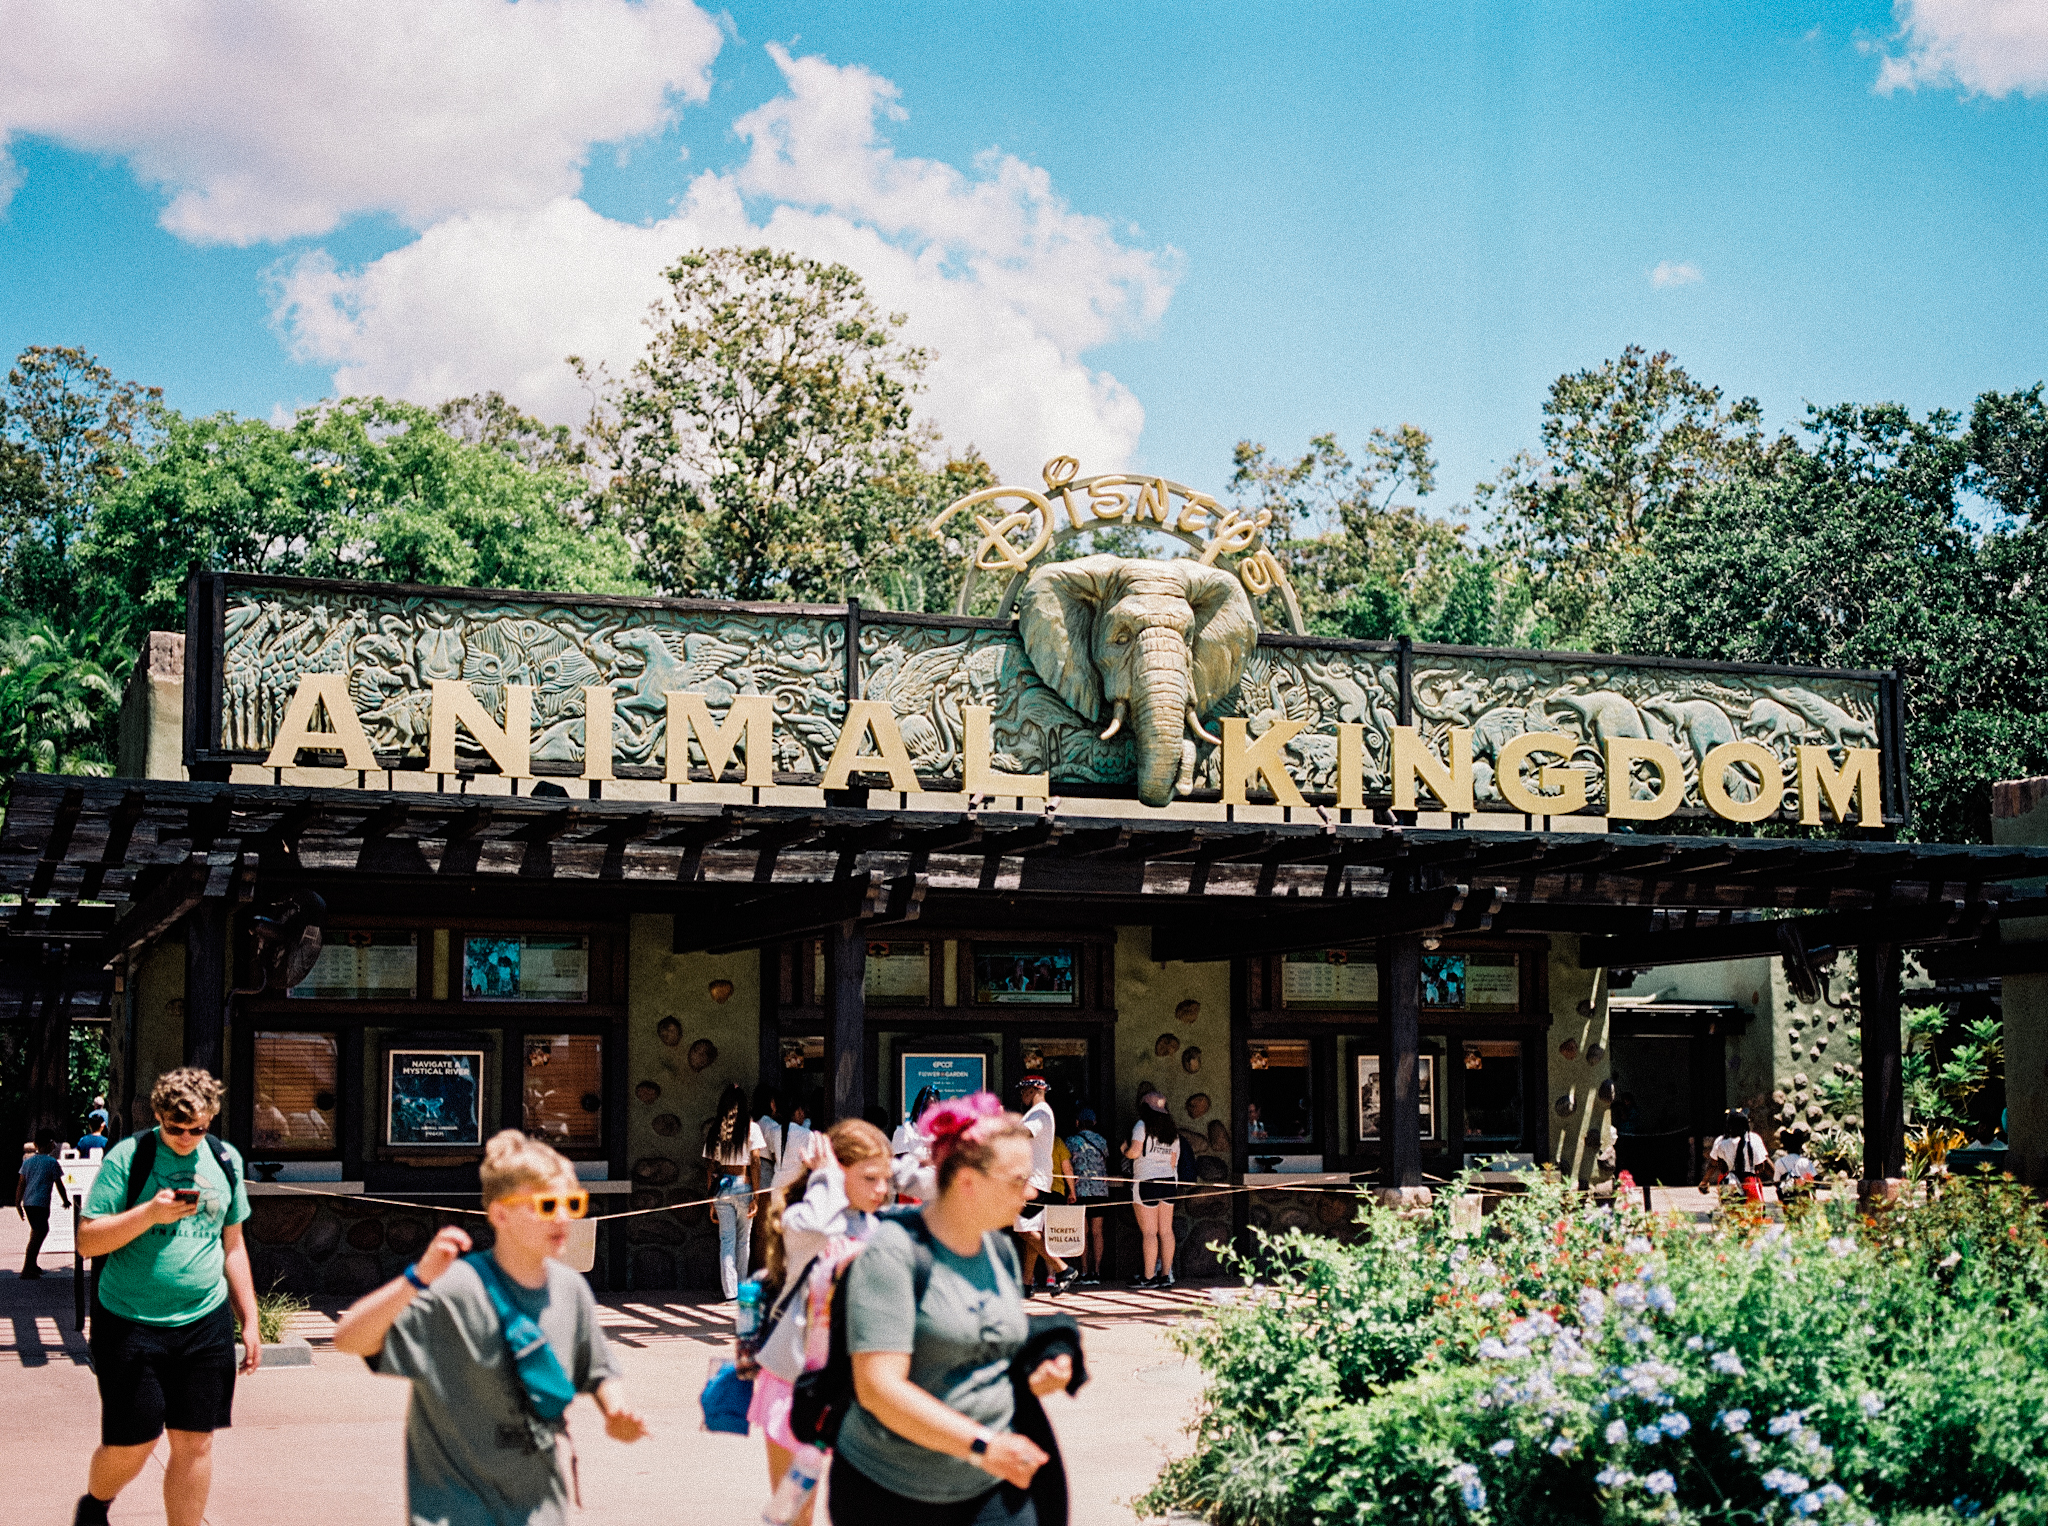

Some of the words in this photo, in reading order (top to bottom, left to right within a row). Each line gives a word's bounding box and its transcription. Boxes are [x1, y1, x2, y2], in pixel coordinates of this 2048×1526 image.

[261, 673, 1050, 799] ANIMAL
[1219, 716, 1885, 829] KINGDOM
[411, 1060, 453, 1068] NAVIGATE
[932, 1061, 954, 1069] EPCOT
[402, 1067, 444, 1075] MYSTICAL
[445, 1068, 470, 1076] RIVER
[170, 1229, 188, 1238] ALL
